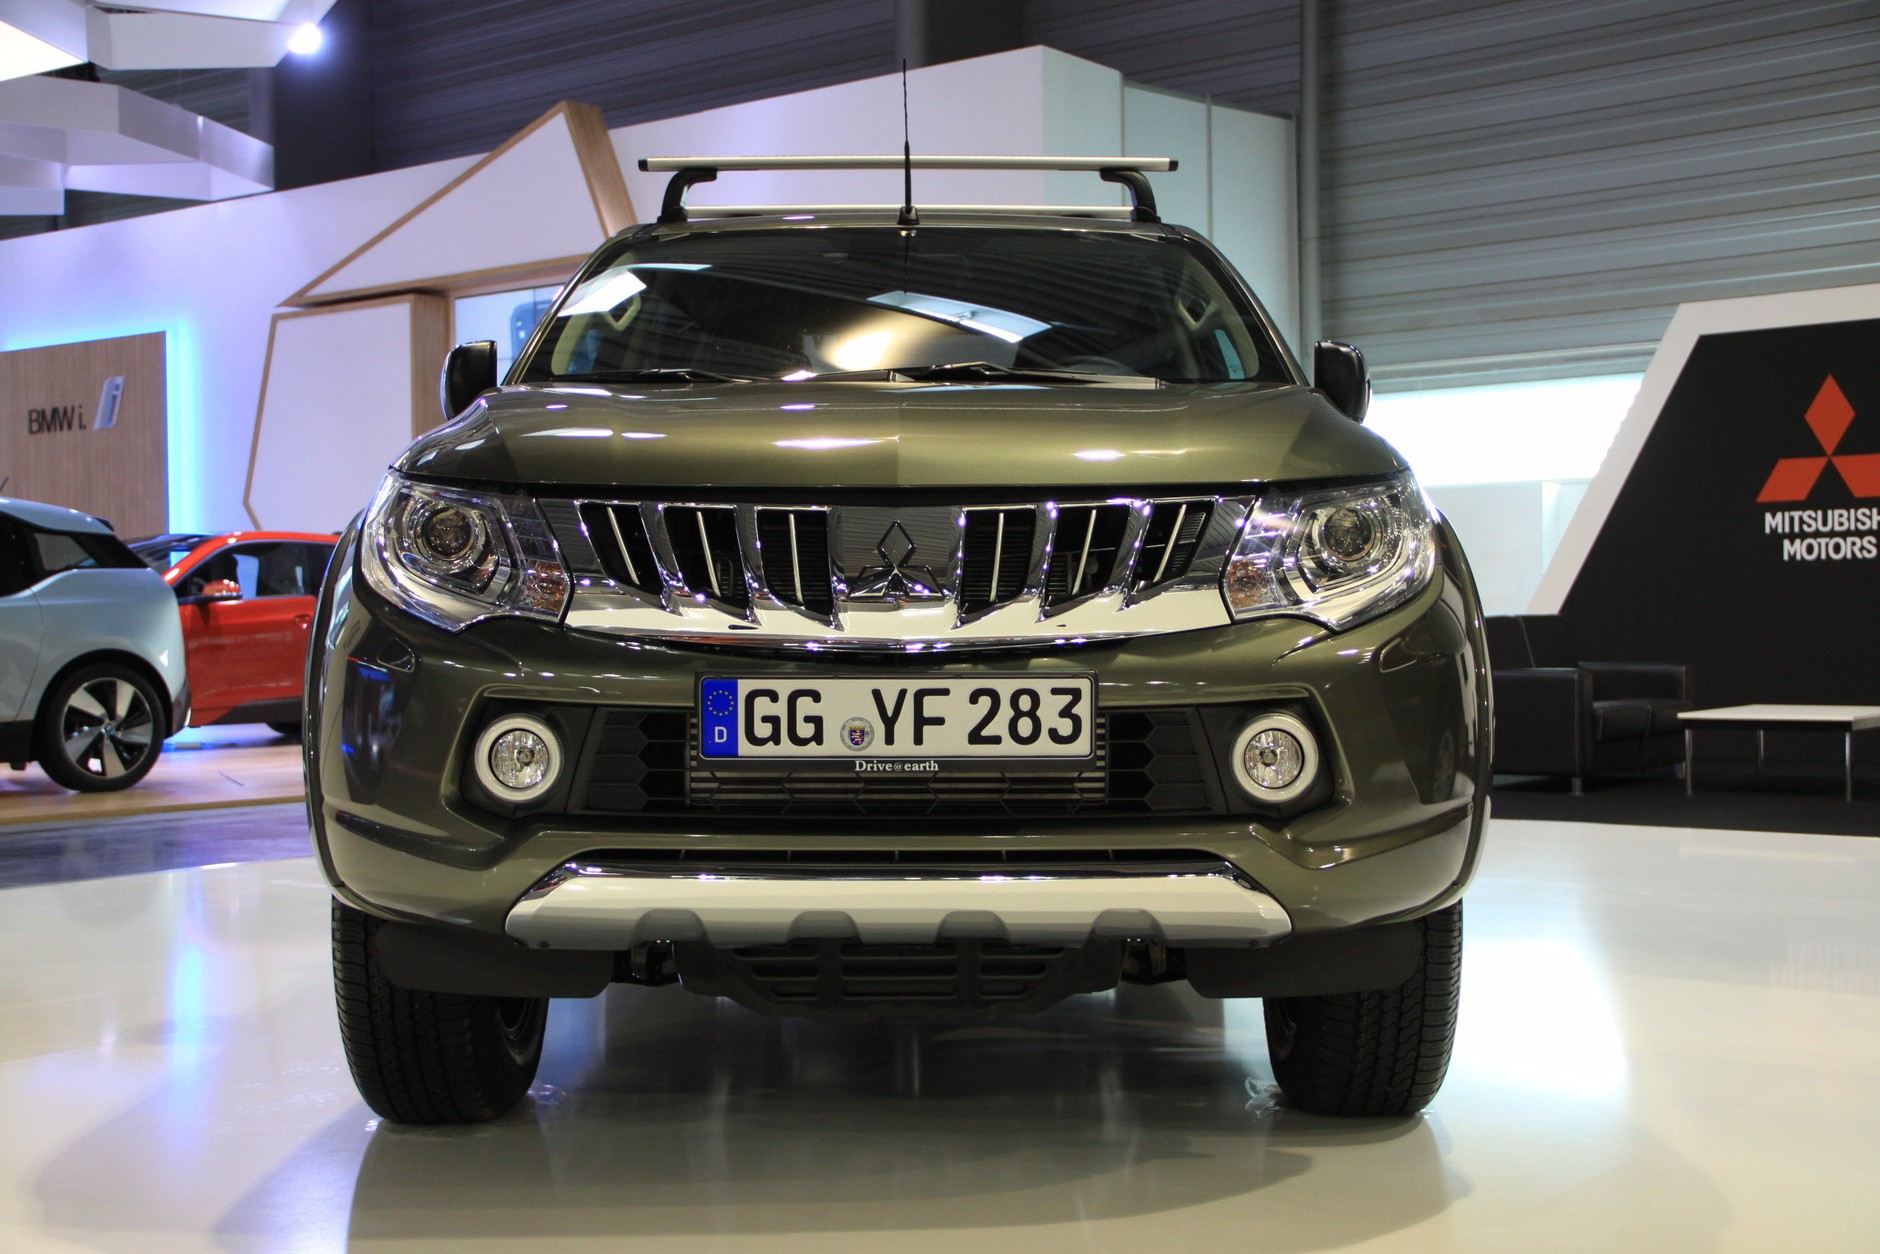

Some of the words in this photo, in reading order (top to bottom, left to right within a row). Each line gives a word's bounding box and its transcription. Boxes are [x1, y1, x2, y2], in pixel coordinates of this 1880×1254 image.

[28, 405, 75, 435] BMW
[1782, 535, 1878, 562] MOTORS
[744, 688, 824, 746] GG
[871, 687, 951, 746] YF
[967, 687, 1083, 746] 283
[714, 726, 727, 743] D
